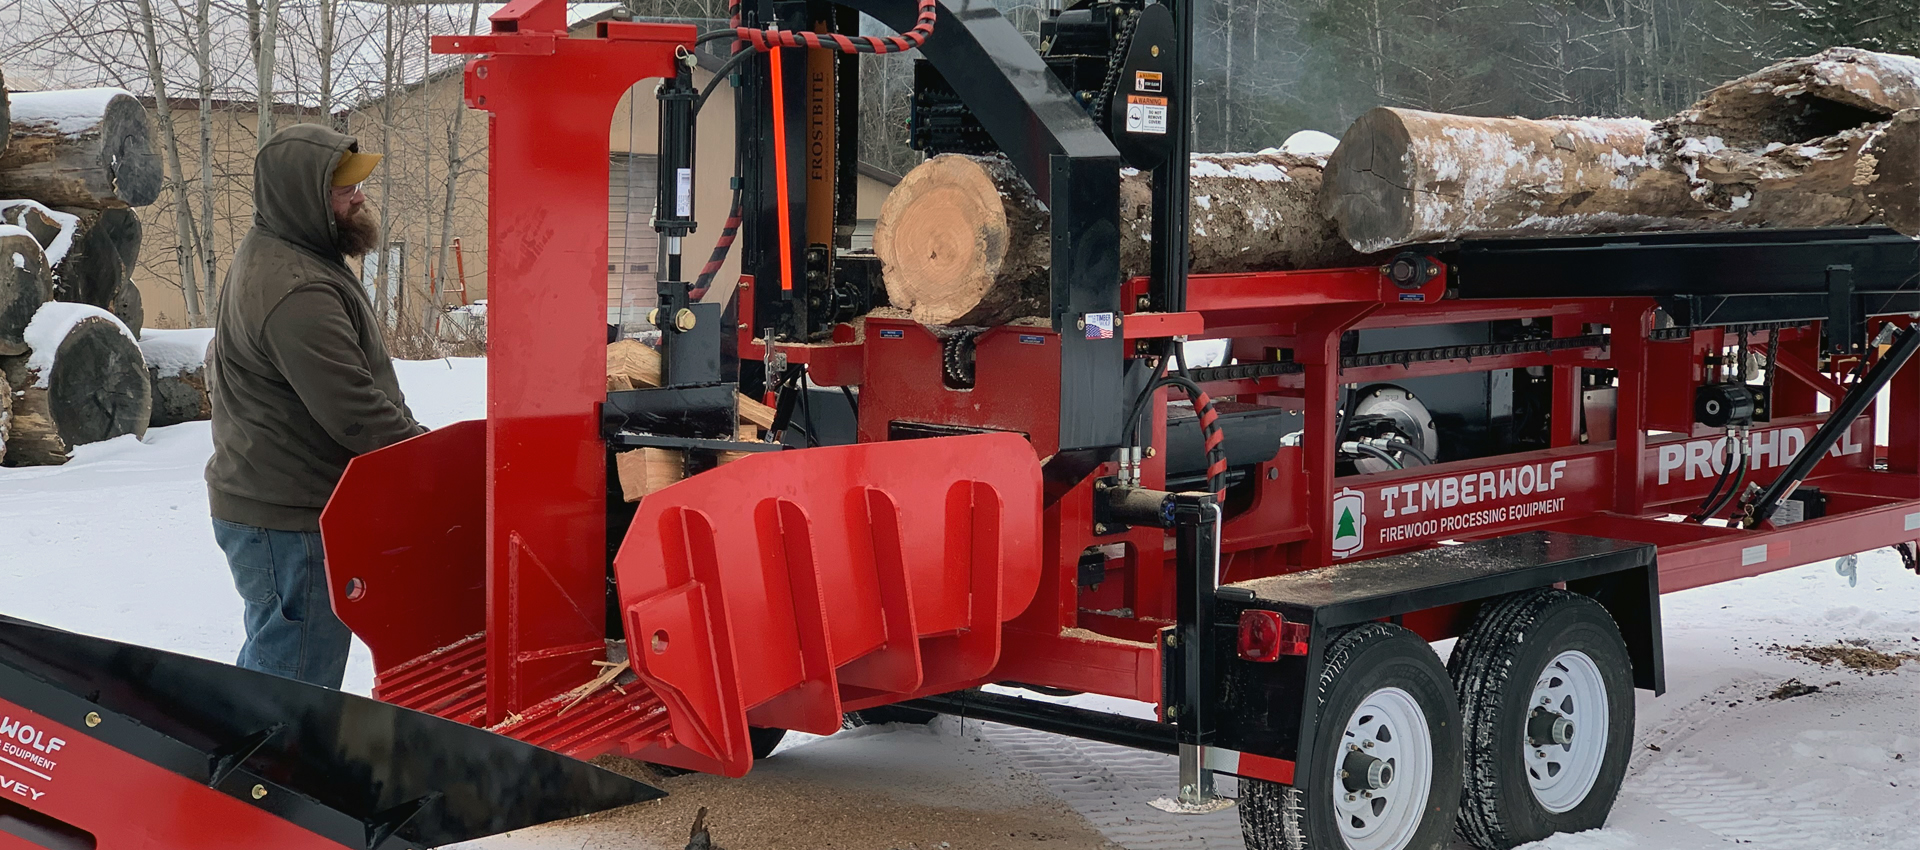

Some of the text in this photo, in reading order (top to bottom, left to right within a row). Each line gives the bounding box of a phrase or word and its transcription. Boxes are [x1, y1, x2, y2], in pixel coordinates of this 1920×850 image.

[1138, 97, 1162, 105] WARNING
[811, 72, 823, 181] FROSTBITE
[1380, 460, 1567, 518] TIMBERWOLF
[1380, 497, 1566, 544] FIREWOOD PROCESSING EQUIPMENT
[2, 742, 57, 771] EQUIPMENT
